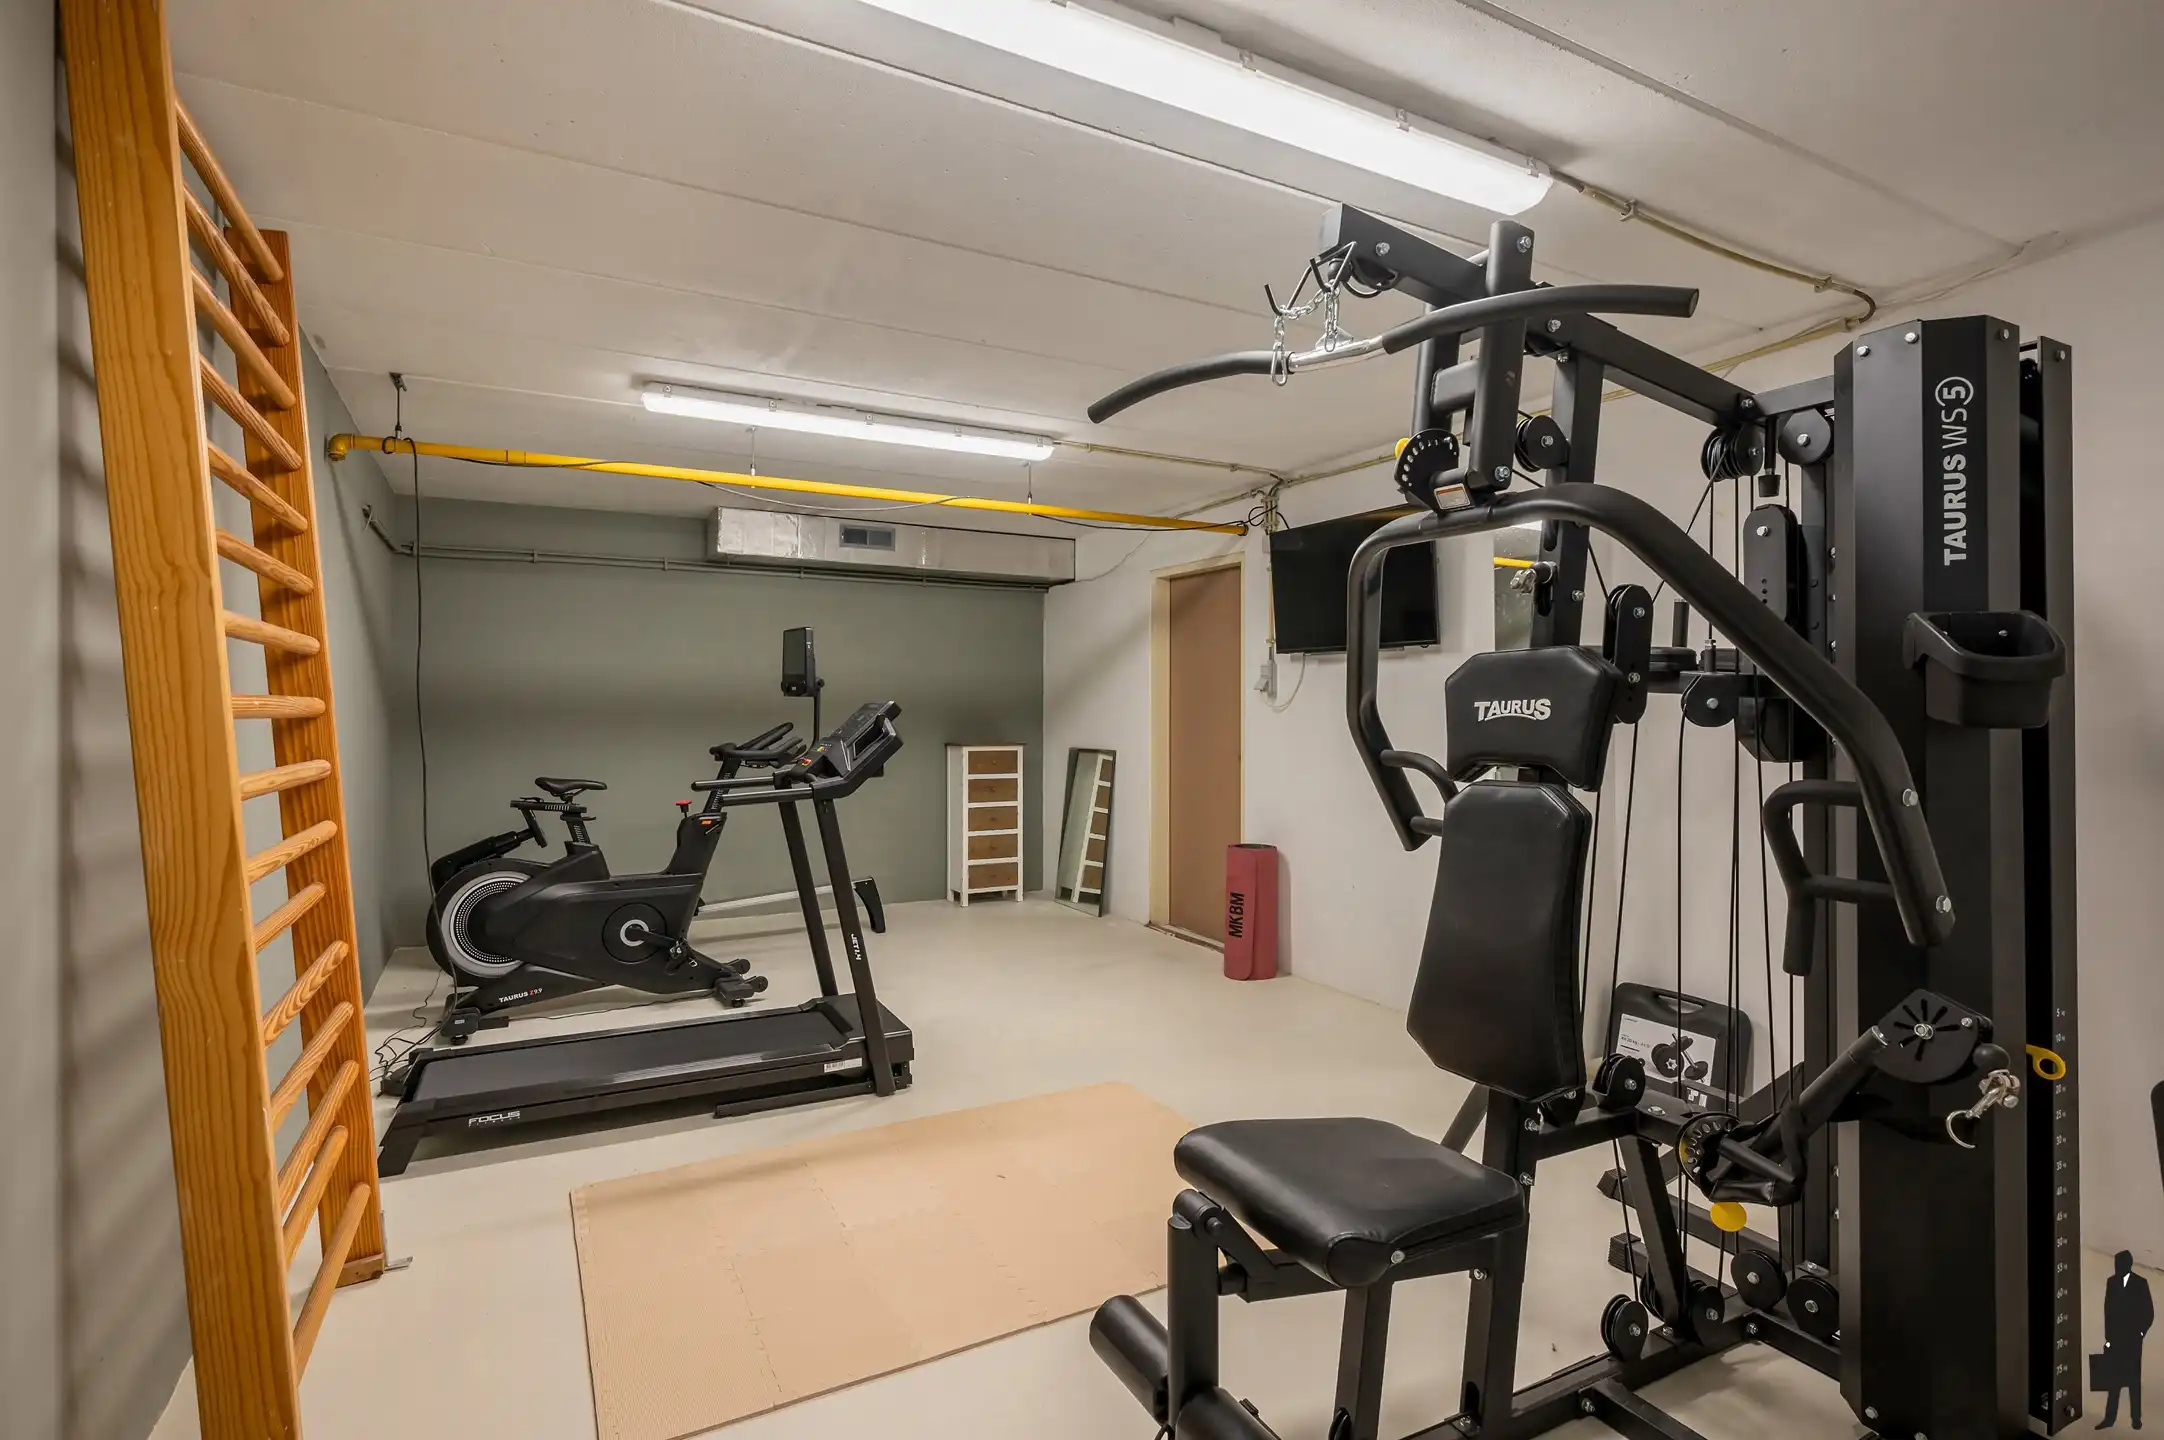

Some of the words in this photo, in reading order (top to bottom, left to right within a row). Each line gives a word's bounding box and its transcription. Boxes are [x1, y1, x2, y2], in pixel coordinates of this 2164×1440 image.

[1943, 454, 1967, 566] TAURUS
[1473, 698, 1552, 722] TAURUS
[1228, 892, 1245, 938] MKBM
[498, 991, 529, 1003] TAURUS
[468, 1110, 520, 1125] FOCUS
